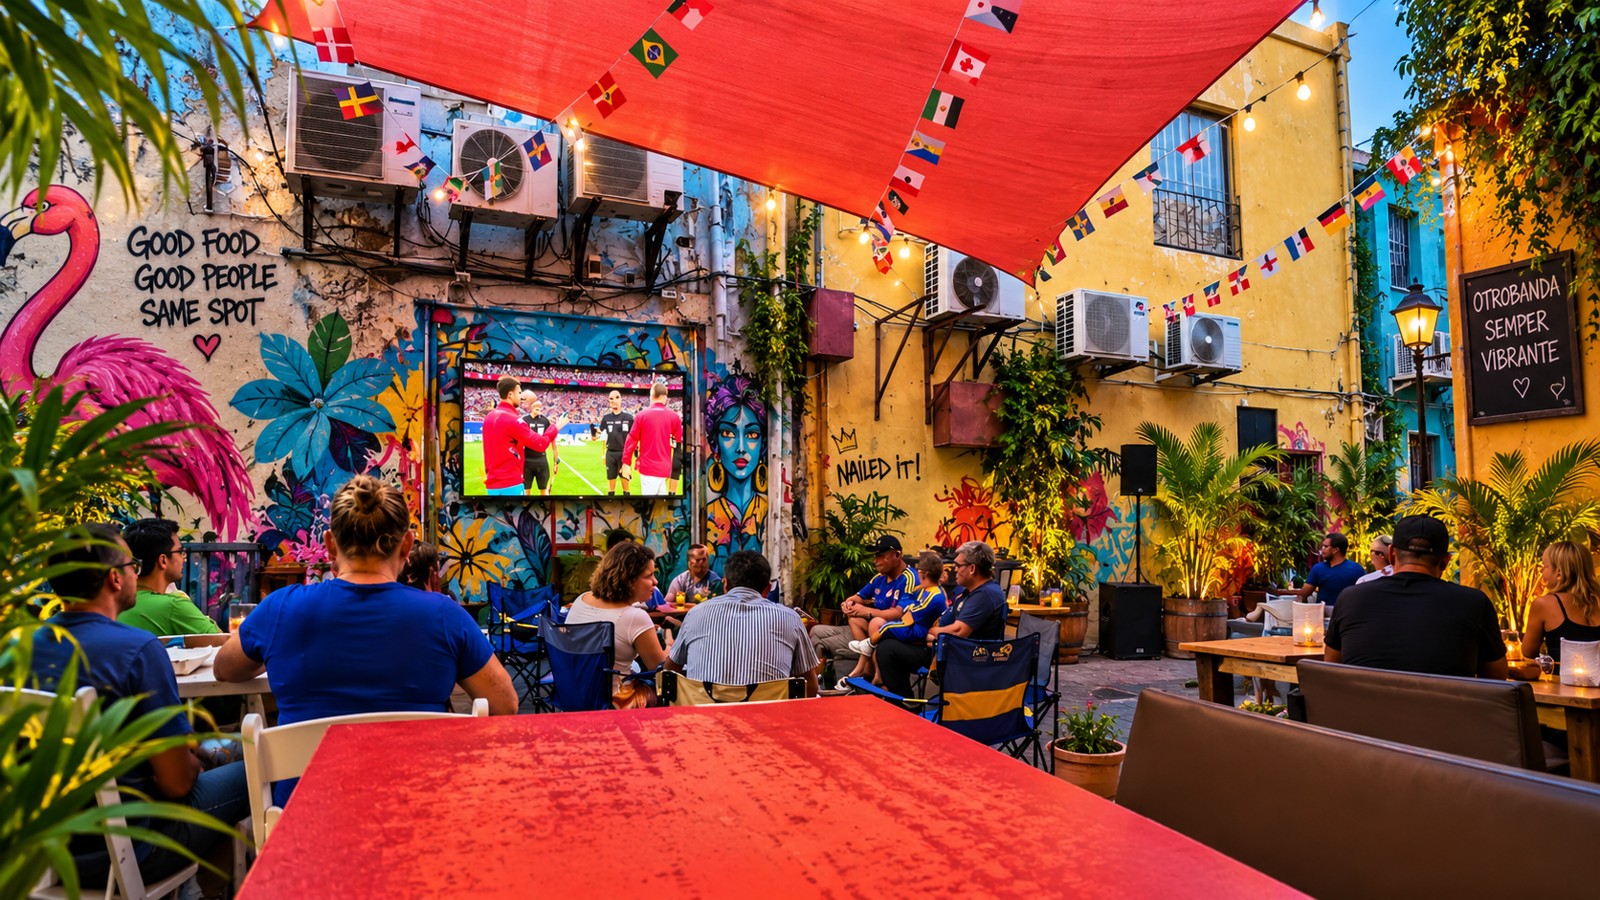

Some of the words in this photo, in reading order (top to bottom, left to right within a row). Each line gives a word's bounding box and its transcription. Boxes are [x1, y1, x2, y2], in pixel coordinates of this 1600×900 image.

[127, 226, 195, 260] GOOD
[202, 228, 260, 258] FOOD
[134, 264, 196, 294] GOOD
[202, 263, 278, 291] PEOPLE
[1473, 275, 1560, 313] OTROBANDA
[140, 298, 201, 328] SAME
[208, 298, 265, 326] SPOT
[1485, 310, 1549, 341] SEMPER
